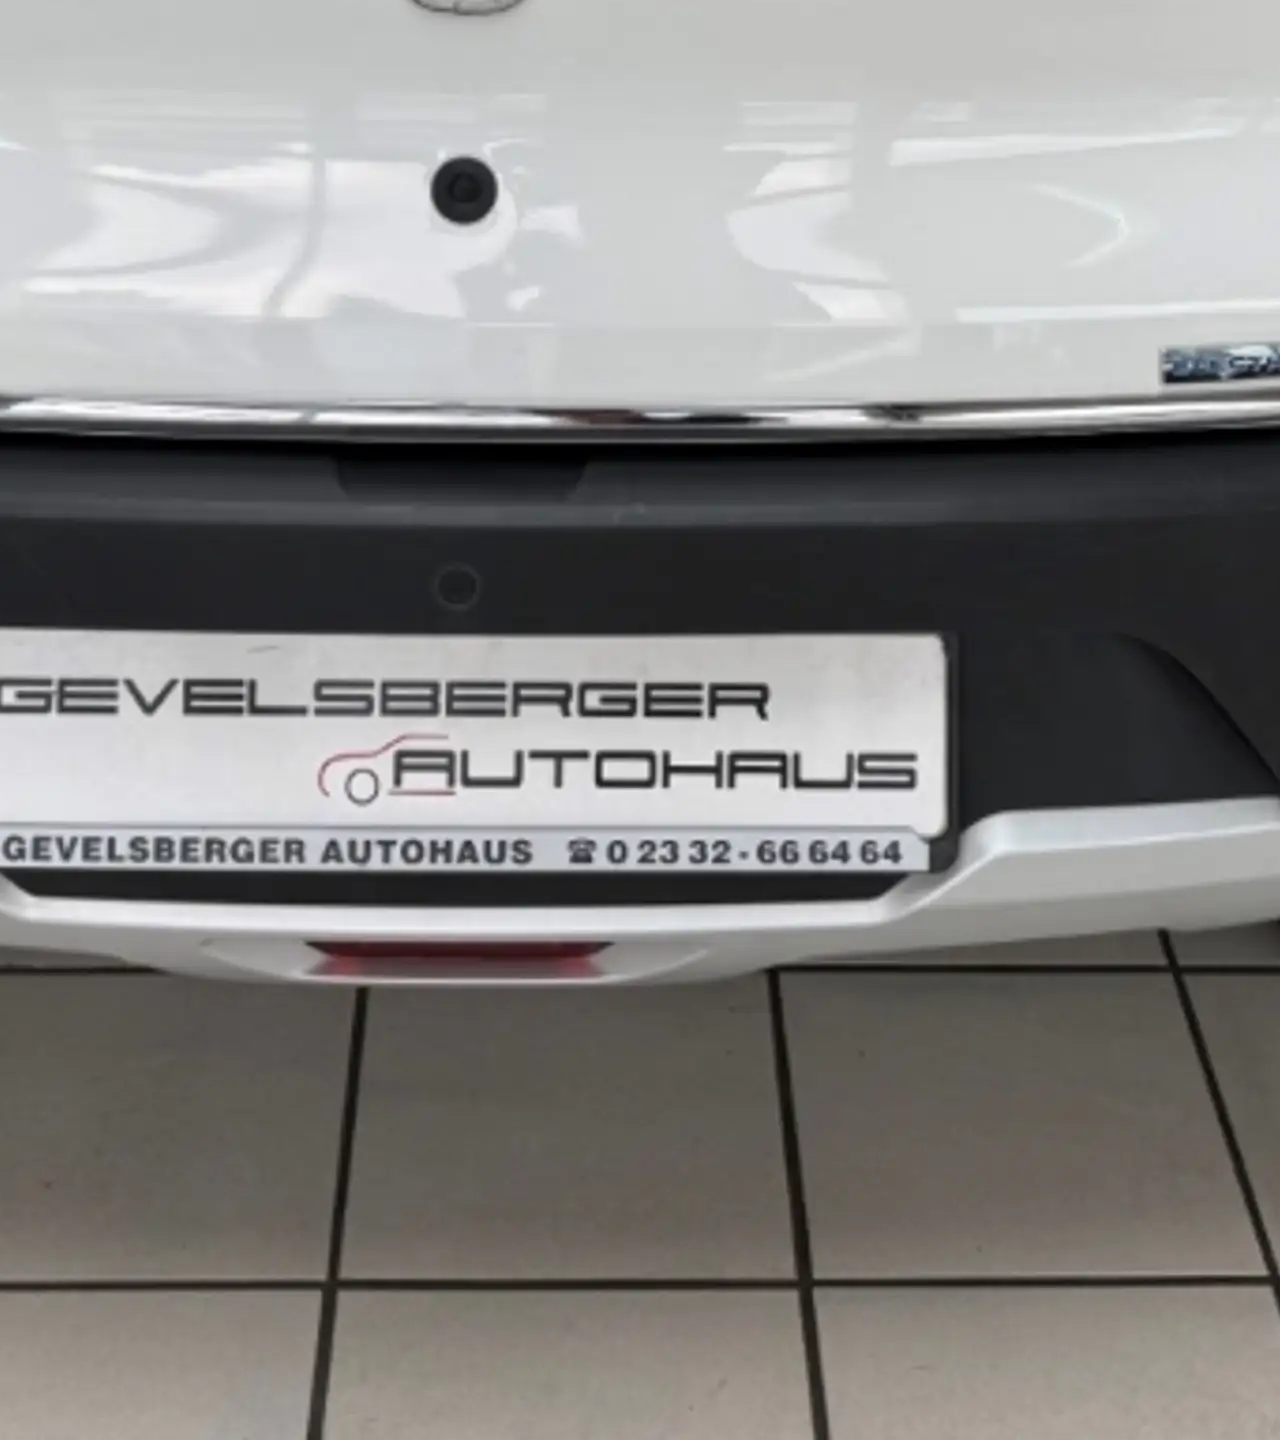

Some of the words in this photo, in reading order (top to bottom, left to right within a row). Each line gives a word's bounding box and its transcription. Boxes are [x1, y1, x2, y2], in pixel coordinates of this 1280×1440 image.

[393, 749, 918, 790] AUTOHAUS
[1, 835, 306, 865] GEVELSBERGER
[320, 838, 534, 866] AUTOHAUS
